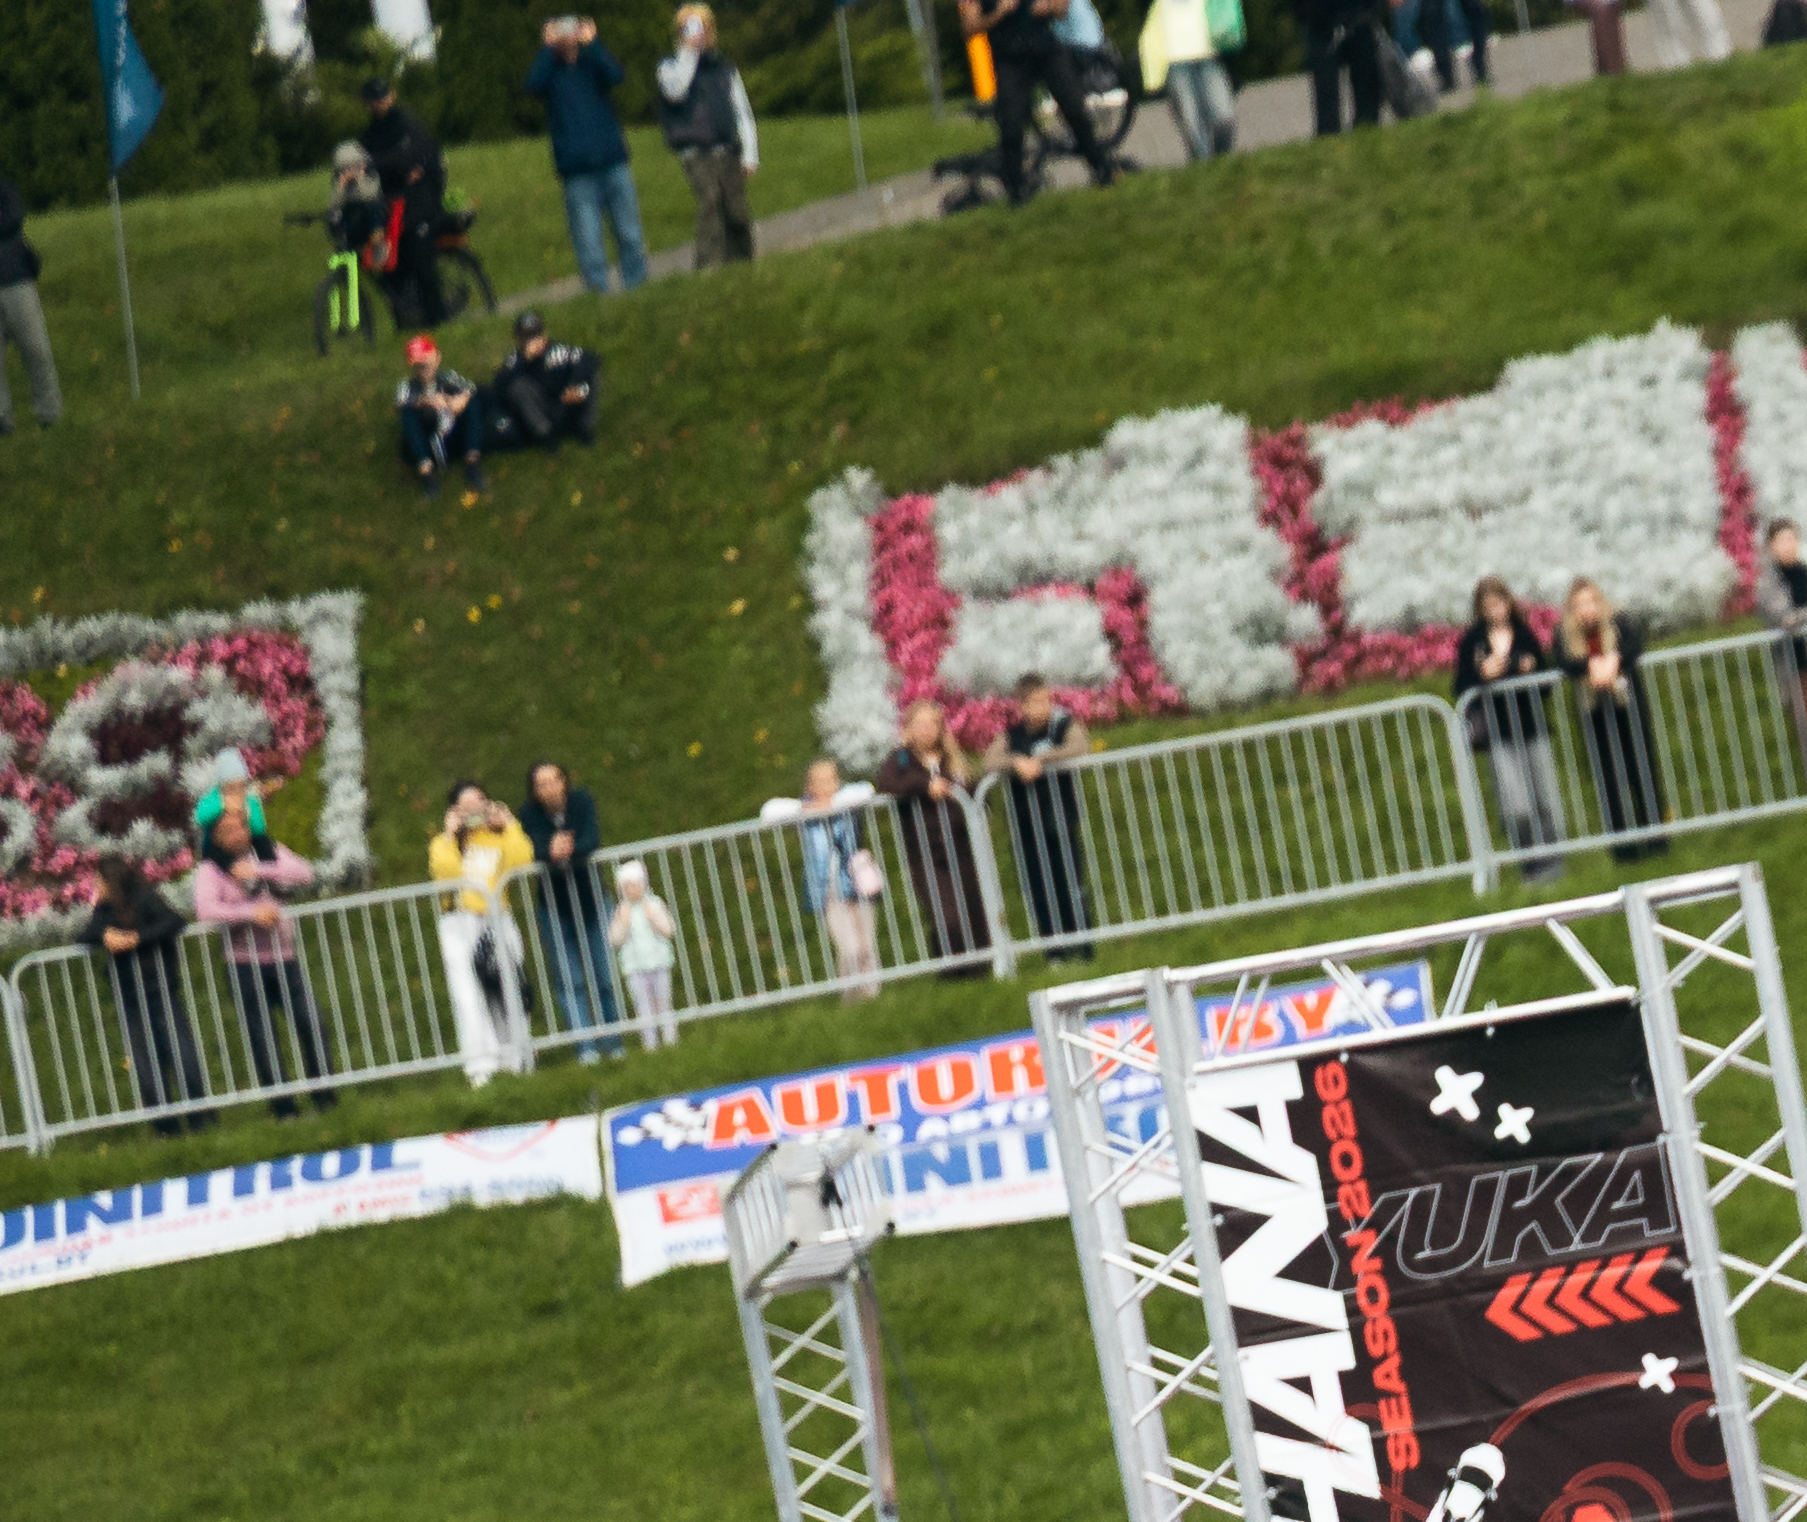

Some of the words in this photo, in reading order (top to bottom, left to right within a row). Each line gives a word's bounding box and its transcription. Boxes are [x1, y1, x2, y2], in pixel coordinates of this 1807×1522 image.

[1314, 1060, 1373, 1222] 2026
[1322, 1136, 1682, 1294] YUKA
[1334, 1226, 1422, 1474] SEASON
